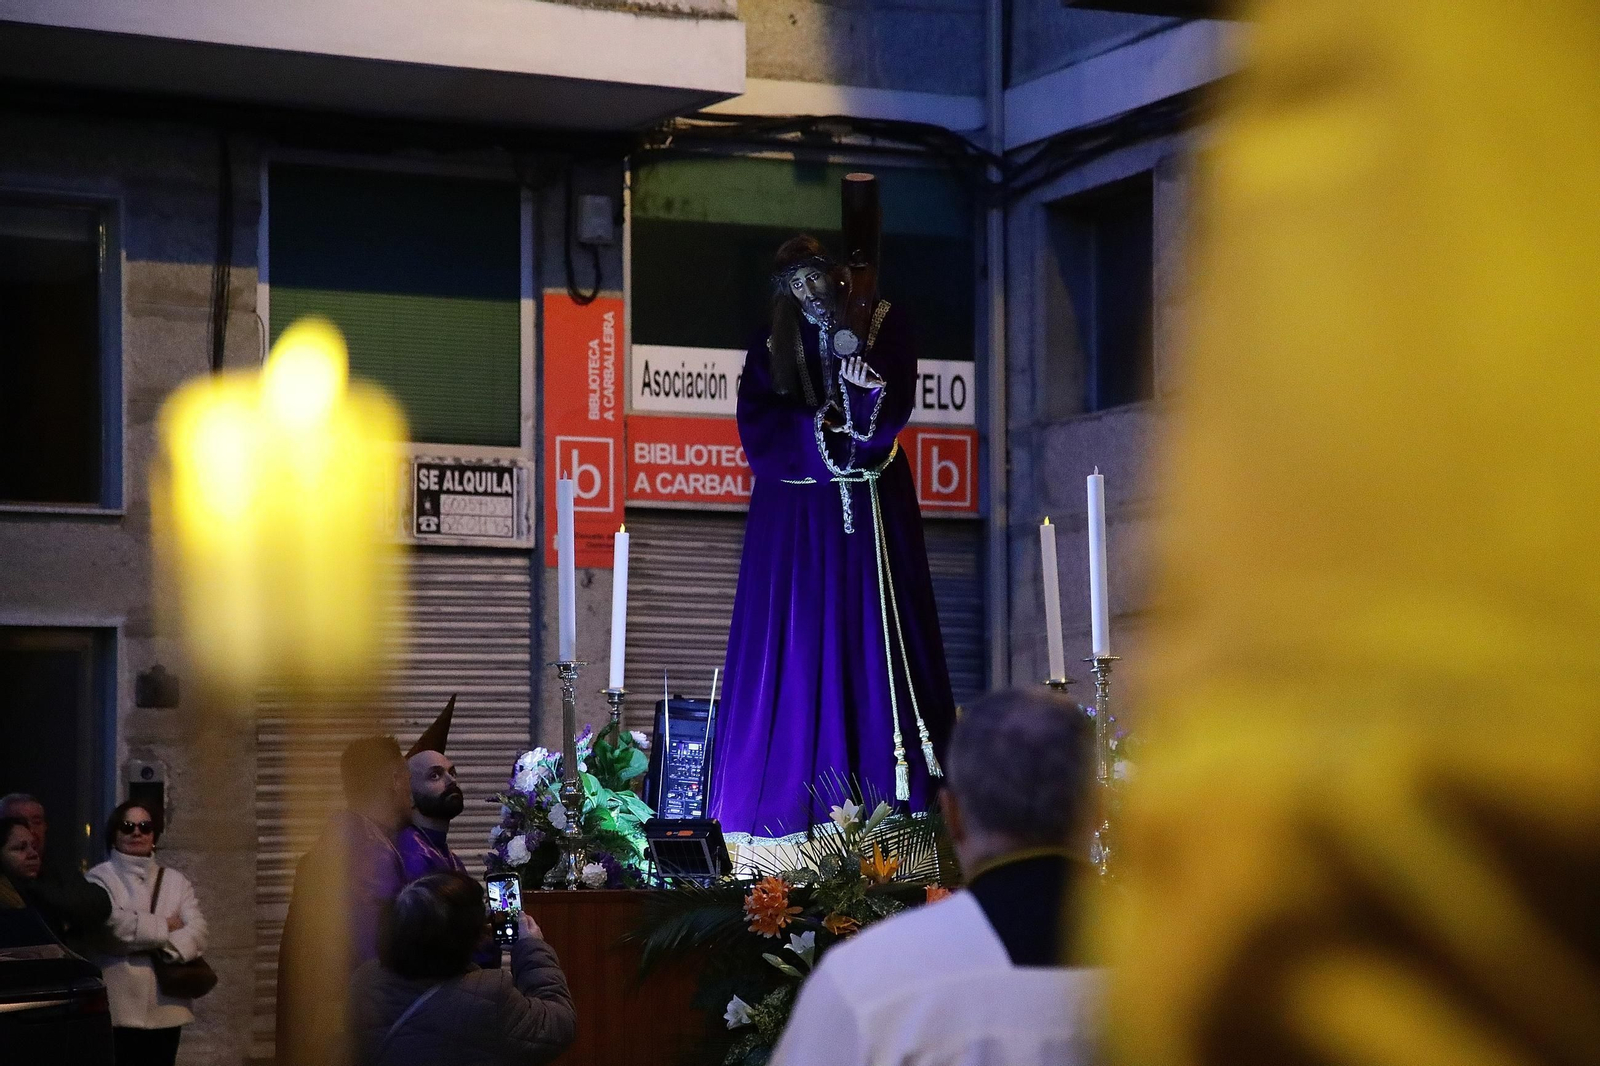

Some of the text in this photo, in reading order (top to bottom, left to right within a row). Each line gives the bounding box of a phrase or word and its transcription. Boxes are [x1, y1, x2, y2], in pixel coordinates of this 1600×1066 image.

[588, 339, 601, 421] BIBLIOTECA
[641, 359, 728, 400] Asociación
[916, 373, 967, 412] ELO
[603, 410, 616, 422] A
[418, 468, 513, 494] SE ALQUILA
[571, 449, 602, 499] b
[633, 475, 653, 494] A
[931, 445, 960, 495] b
